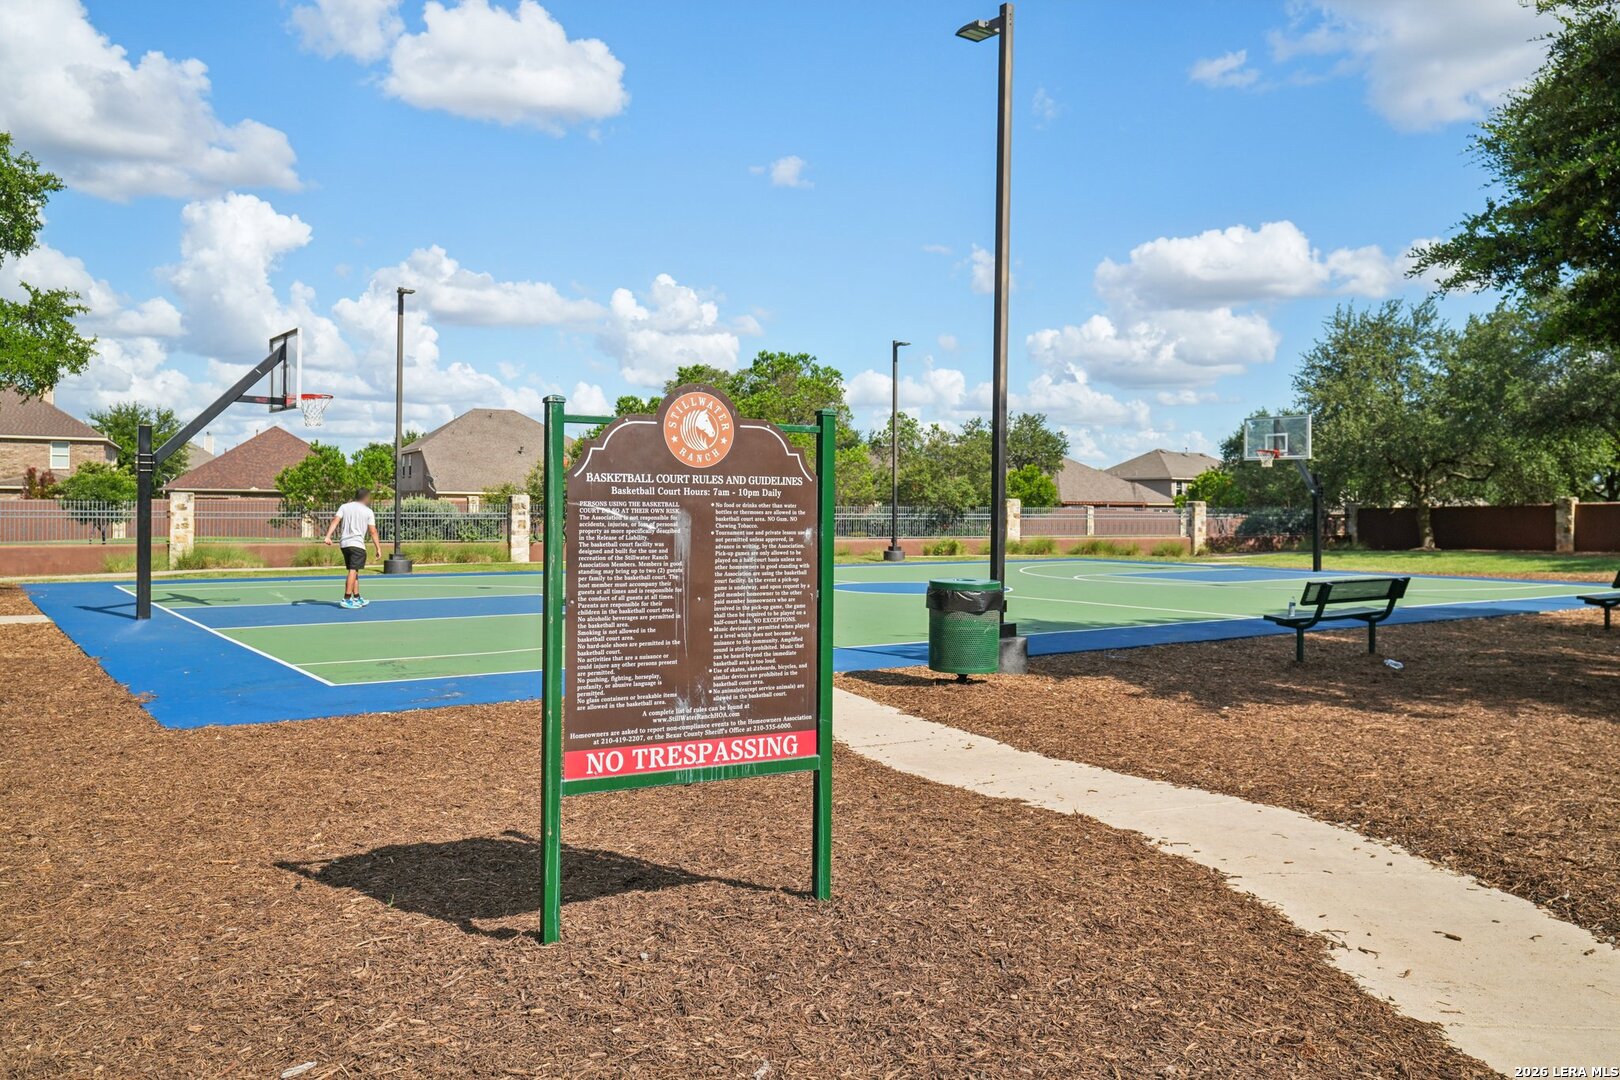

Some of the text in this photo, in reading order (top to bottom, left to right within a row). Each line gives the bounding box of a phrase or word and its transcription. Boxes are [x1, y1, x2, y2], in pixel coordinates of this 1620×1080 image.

[668, 397, 729, 430] STILLWATER
[679, 448, 720, 463] RANCH
[586, 473, 802, 485] BASKETBALL COURT RULES AND GUIDELINES
[611, 487, 655, 495] Basketball
[684, 488, 710, 496] Hours:
[739, 489, 759, 498] 10pm
[762, 489, 781, 498] Daily
[570, 731, 609, 739] Homeowners
[601, 736, 645, 744] 210-419-2207,
[586, 735, 798, 774] NO TRESPASSING
